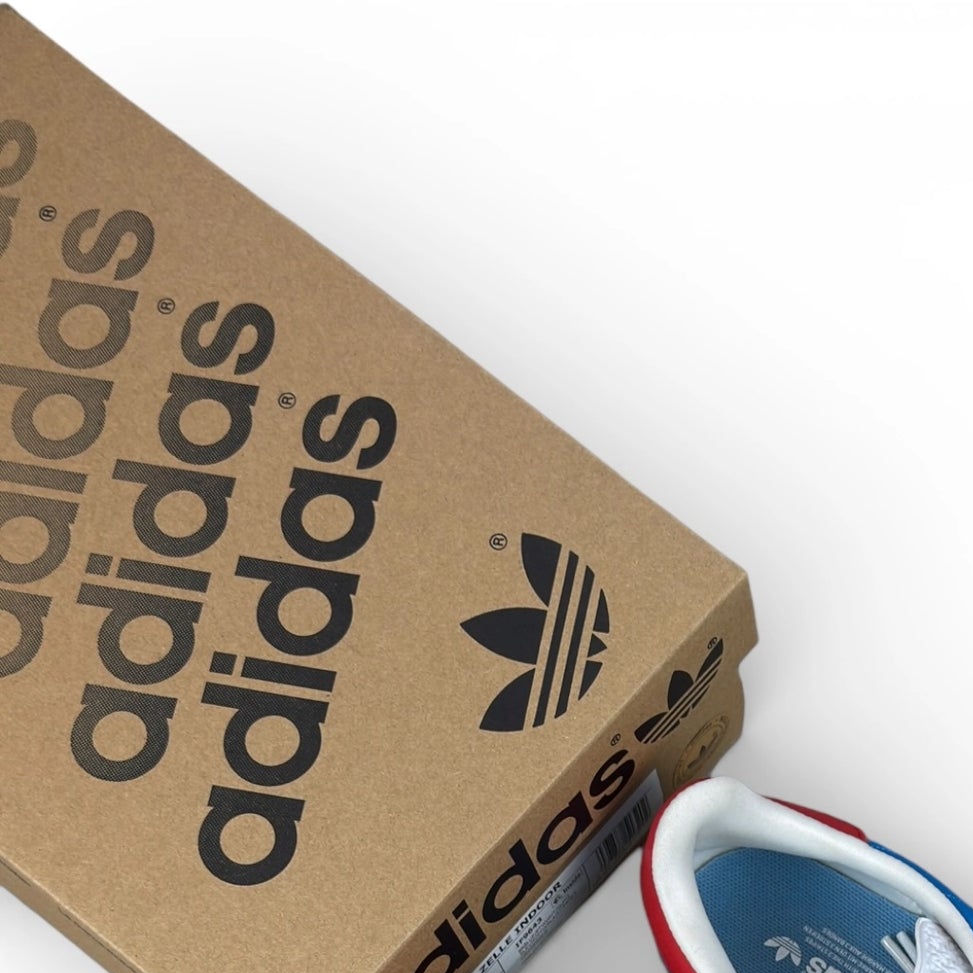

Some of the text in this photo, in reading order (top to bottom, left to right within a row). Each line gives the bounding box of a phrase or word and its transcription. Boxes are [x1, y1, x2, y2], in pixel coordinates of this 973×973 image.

[70, 300, 276, 782] adidas
[197, 393, 398, 887] adidas
[513, 881, 562, 935] INDOOR
